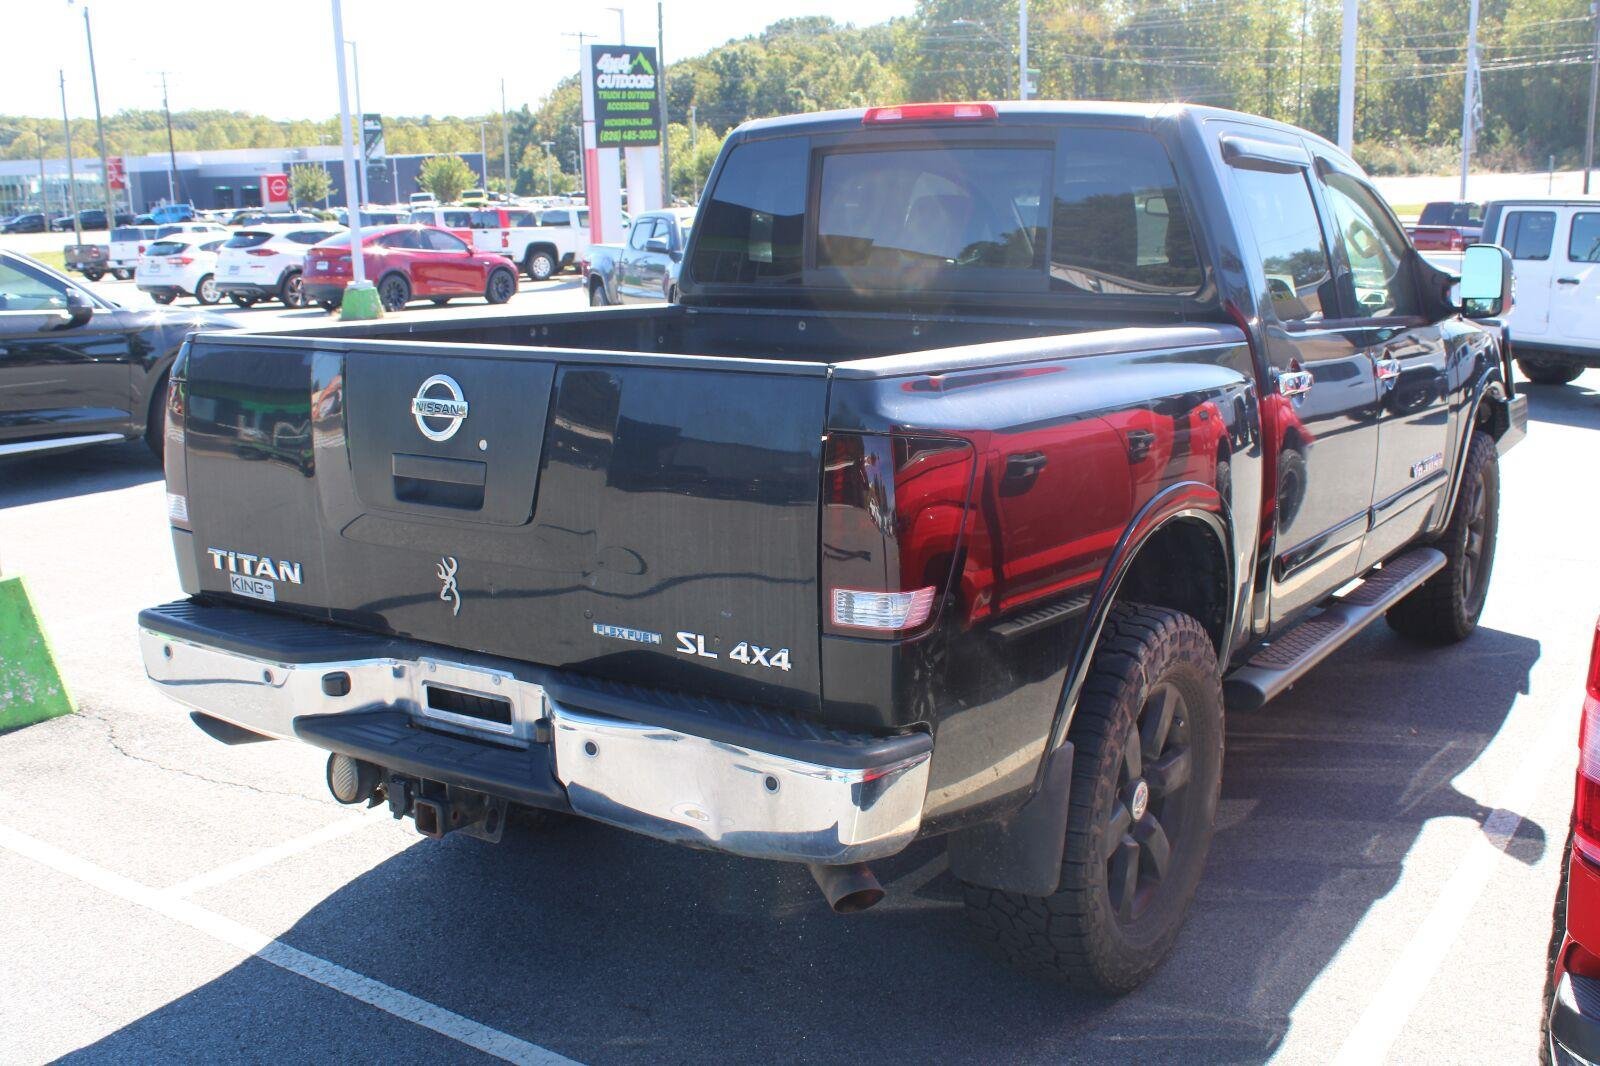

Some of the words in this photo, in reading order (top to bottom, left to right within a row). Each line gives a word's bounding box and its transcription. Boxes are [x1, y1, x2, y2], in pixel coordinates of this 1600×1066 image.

[597, 74, 655, 89] OUTDOORS
[415, 401, 459, 414] NISSAN
[207, 547, 303, 585] TITAN
[231, 576, 264, 595] KING
[596, 624, 626, 639] FLEX
[627, 629, 657, 644] FUEL
[676, 631, 718, 660] SL
